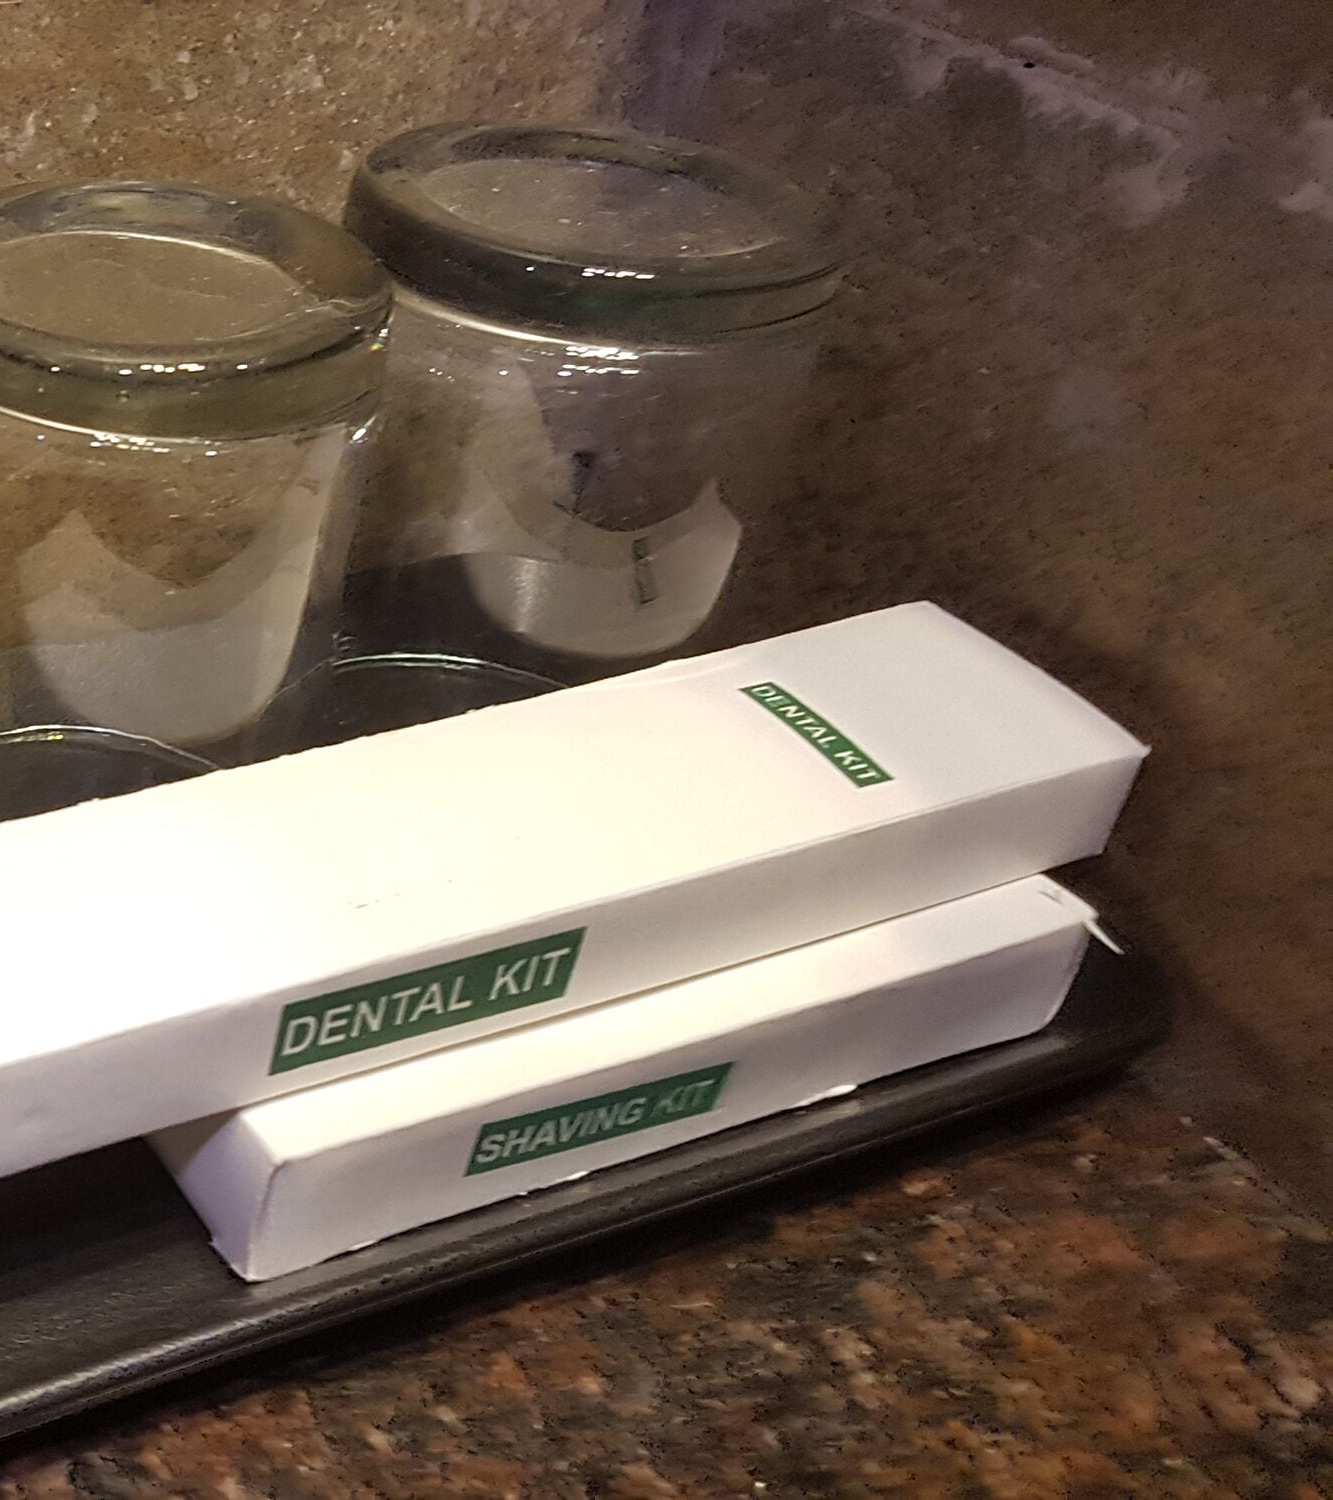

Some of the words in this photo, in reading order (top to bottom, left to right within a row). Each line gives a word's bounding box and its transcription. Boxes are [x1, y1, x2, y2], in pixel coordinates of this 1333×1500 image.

[750, 685, 837, 749] DENTAL
[833, 750, 882, 780] KIT
[279, 975, 473, 1056] DENTAL
[488, 947, 572, 1001] KIT
[474, 1097, 647, 1164] SHAVING
[650, 1078, 715, 1118] KIT
